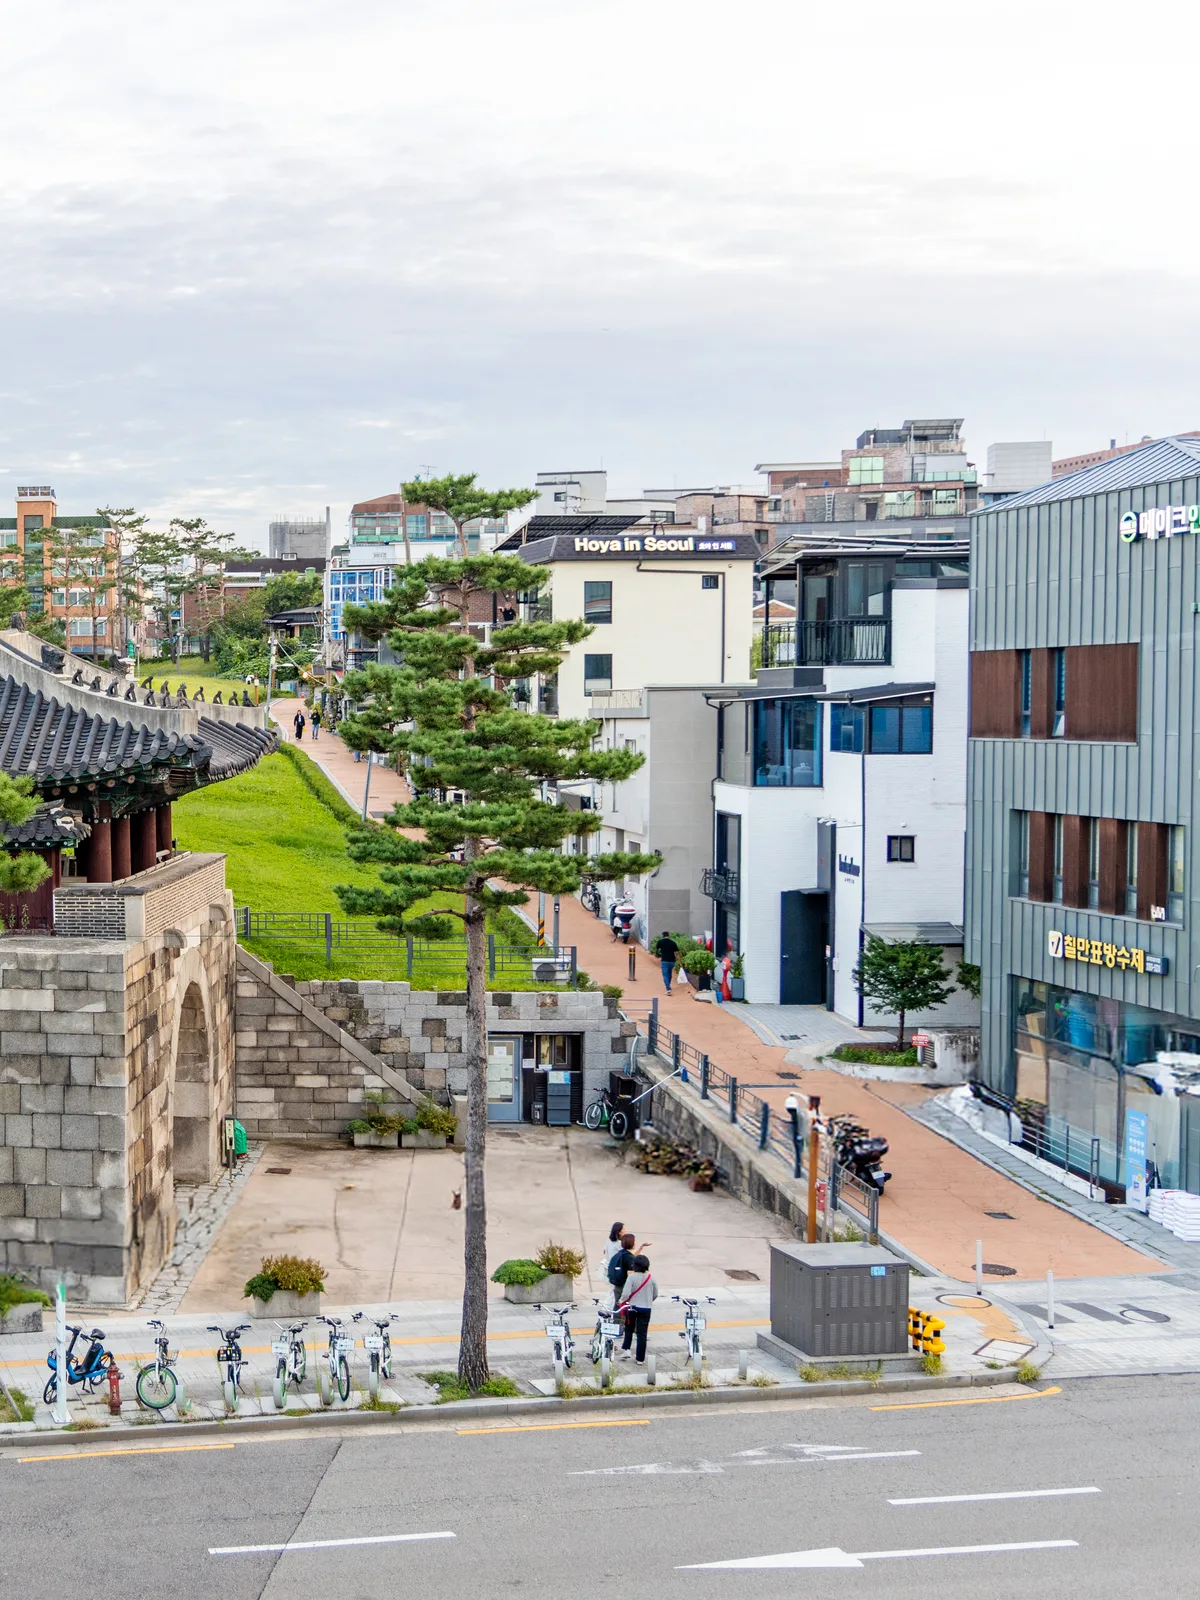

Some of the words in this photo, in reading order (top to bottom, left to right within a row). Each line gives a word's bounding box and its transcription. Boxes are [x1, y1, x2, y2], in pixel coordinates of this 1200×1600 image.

[574, 537, 622, 553] Hoya
[623, 537, 642, 551] in
[644, 536, 694, 551] Seoul
[1063, 934, 1145, 974] 칠만표방수제
